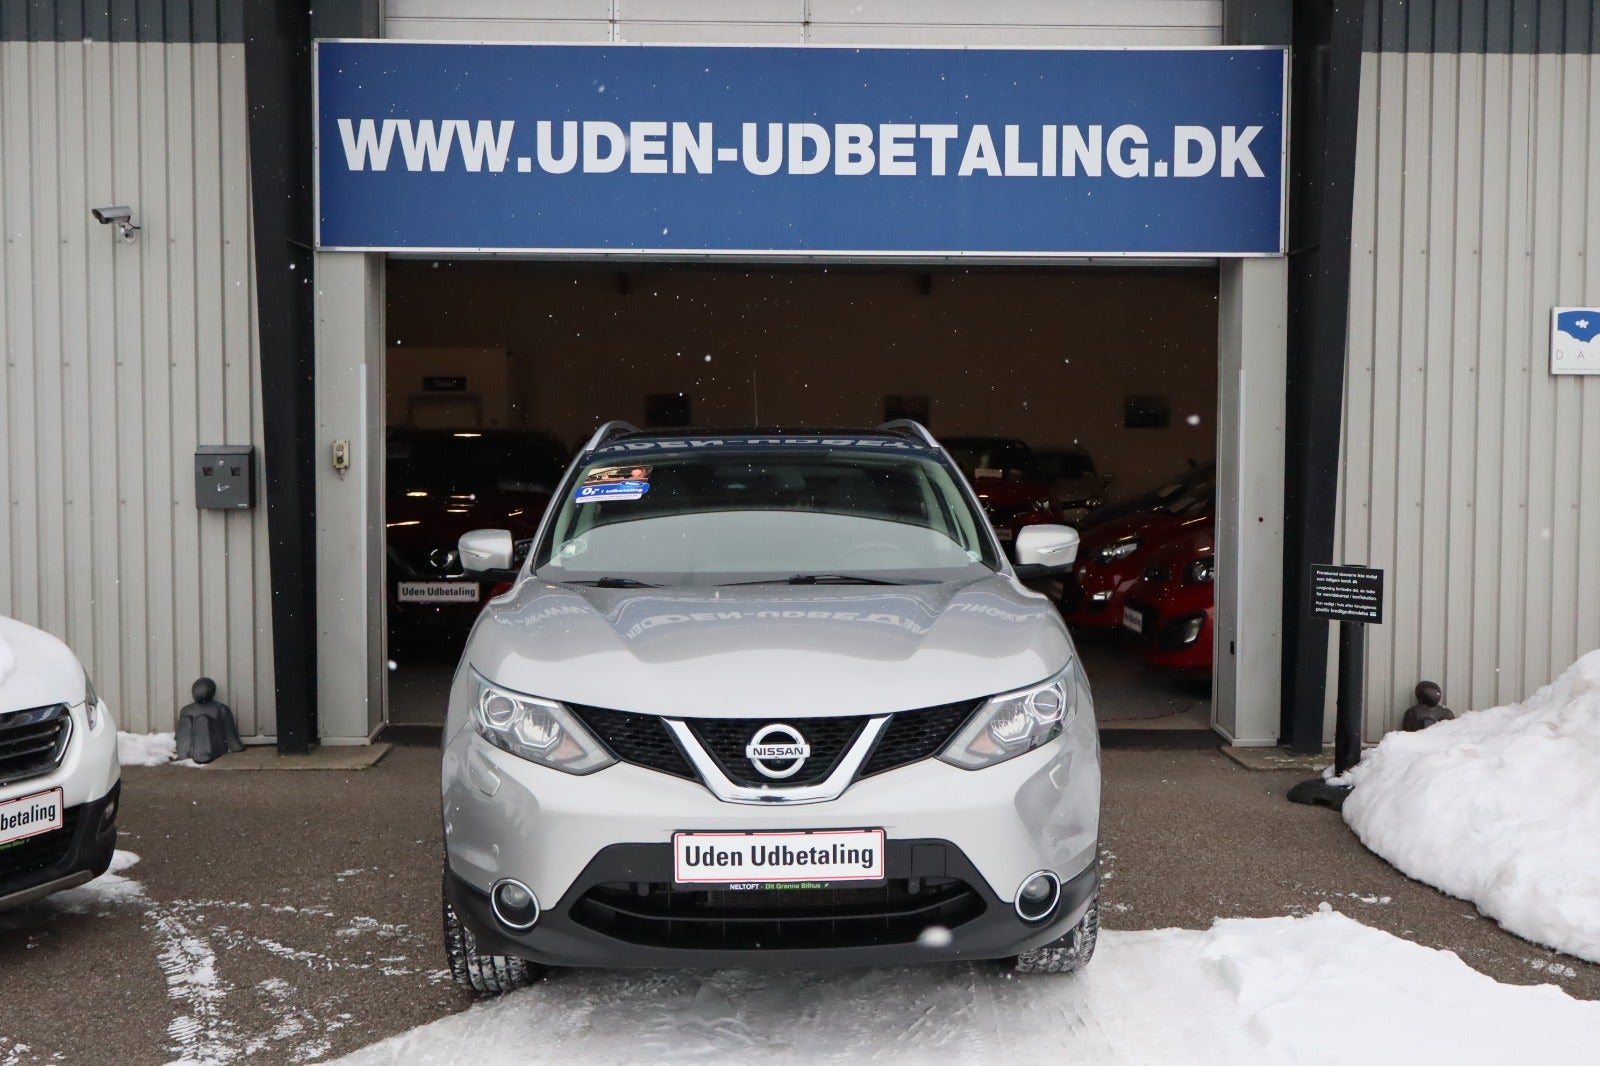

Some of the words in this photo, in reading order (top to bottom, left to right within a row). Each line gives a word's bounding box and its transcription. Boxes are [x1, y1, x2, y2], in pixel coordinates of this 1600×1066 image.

[337, 118, 1265, 178] WWW.UDEN-UDBETALING.DK
[402, 587, 425, 596] Uden
[427, 587, 476, 597] Udbetaling
[753, 747, 804, 756] NISSAN
[0, 804, 56, 831] betaling
[685, 845, 743, 867] Uden
[751, 844, 874, 869] Udbetaling
